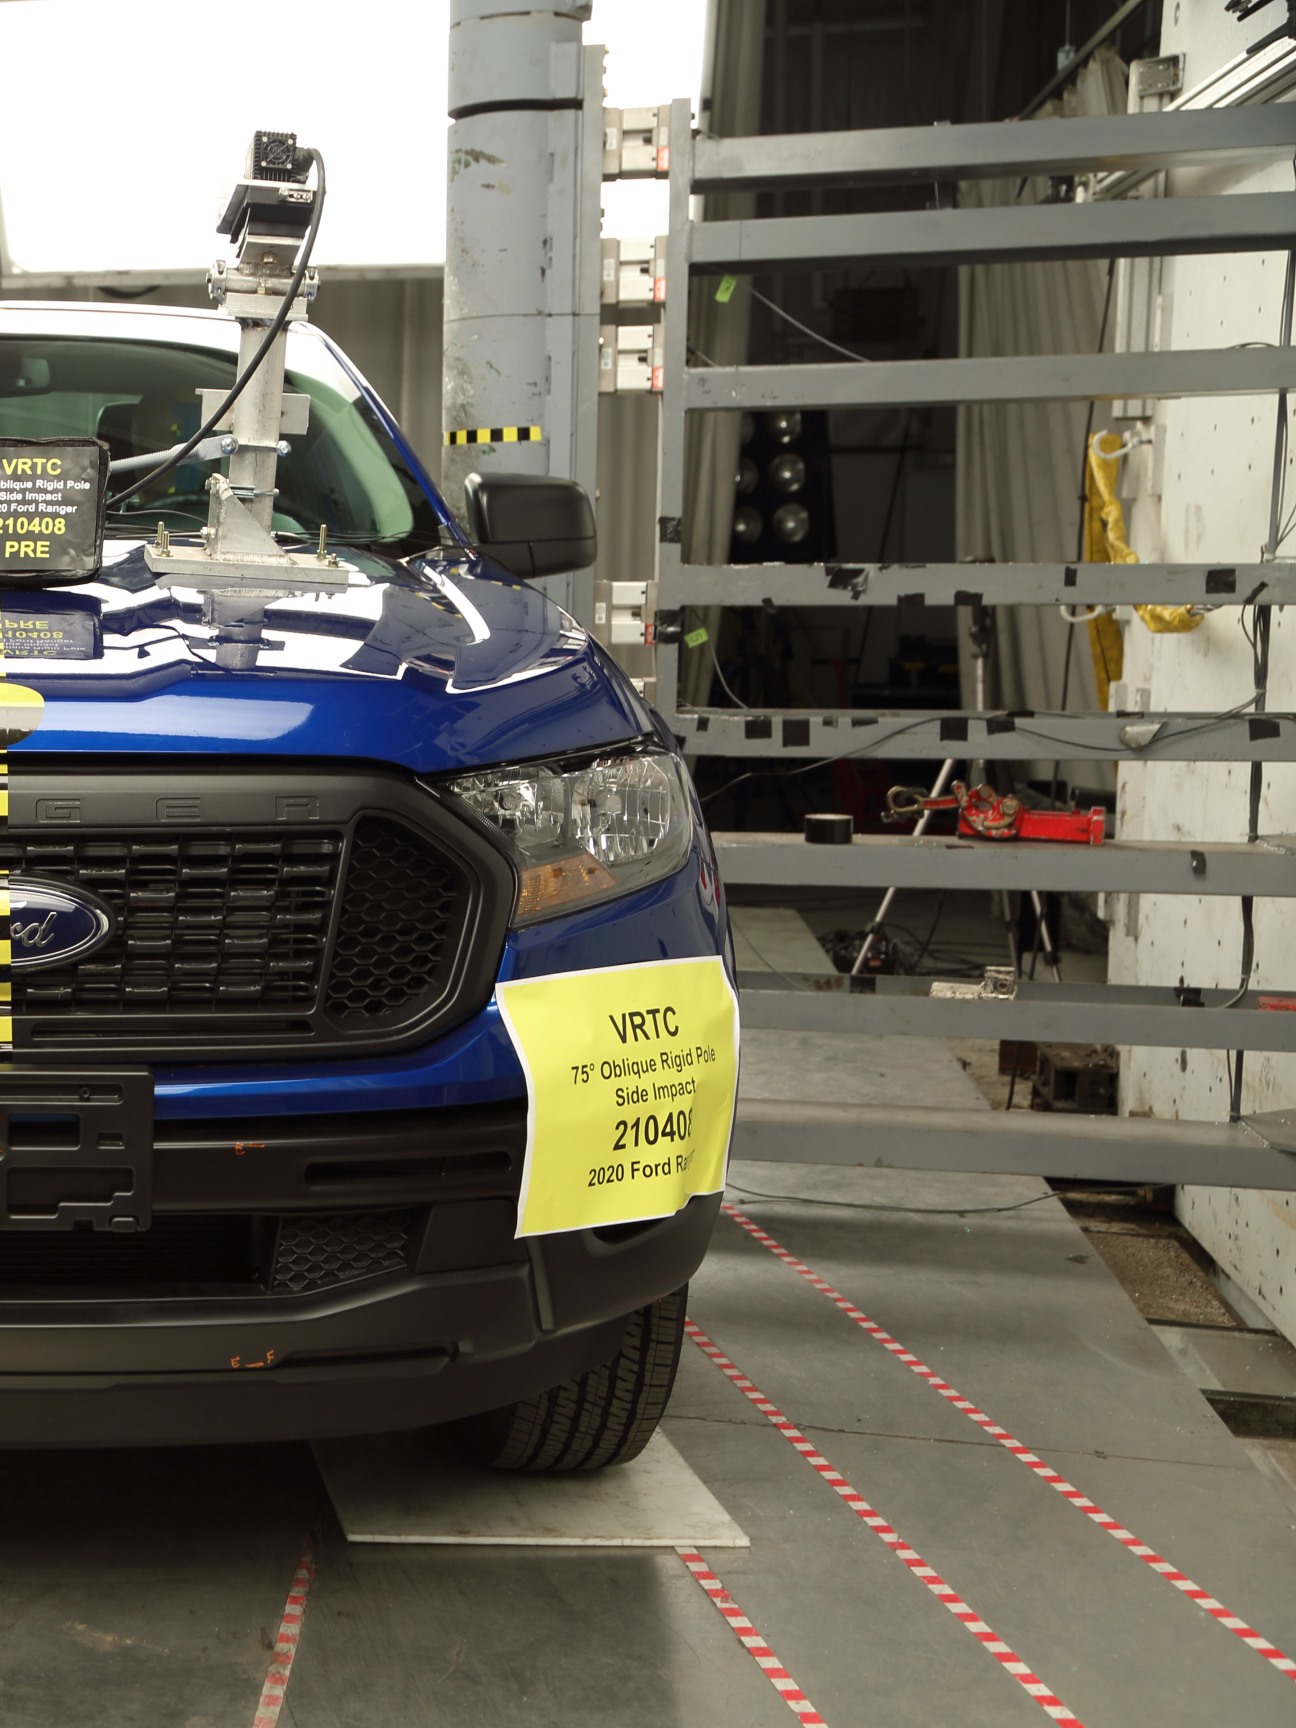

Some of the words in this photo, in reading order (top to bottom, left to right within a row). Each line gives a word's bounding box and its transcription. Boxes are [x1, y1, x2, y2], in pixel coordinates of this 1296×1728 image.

[2, 458, 62, 475] VRTC
[35, 479, 64, 491] Rigid
[66, 480, 91, 490] Pole
[0, 491, 23, 501] Side
[25, 491, 62, 502] Impact
[10, 503, 36, 512] Ford
[38, 503, 78, 515] Ranger
[4, 540, 51, 558] PRE
[609, 1005, 680, 1044] VRTC
[571, 1063, 596, 1085] 75°
[600, 1057, 657, 1080] Oblique
[660, 1048, 694, 1073] Rigid
[696, 1044, 716, 1065] Pole
[615, 1084, 649, 1107] Side
[652, 1076, 697, 1103] Impact
[587, 1162, 625, 1188] 2020
[630, 1156, 672, 1181] Ford
